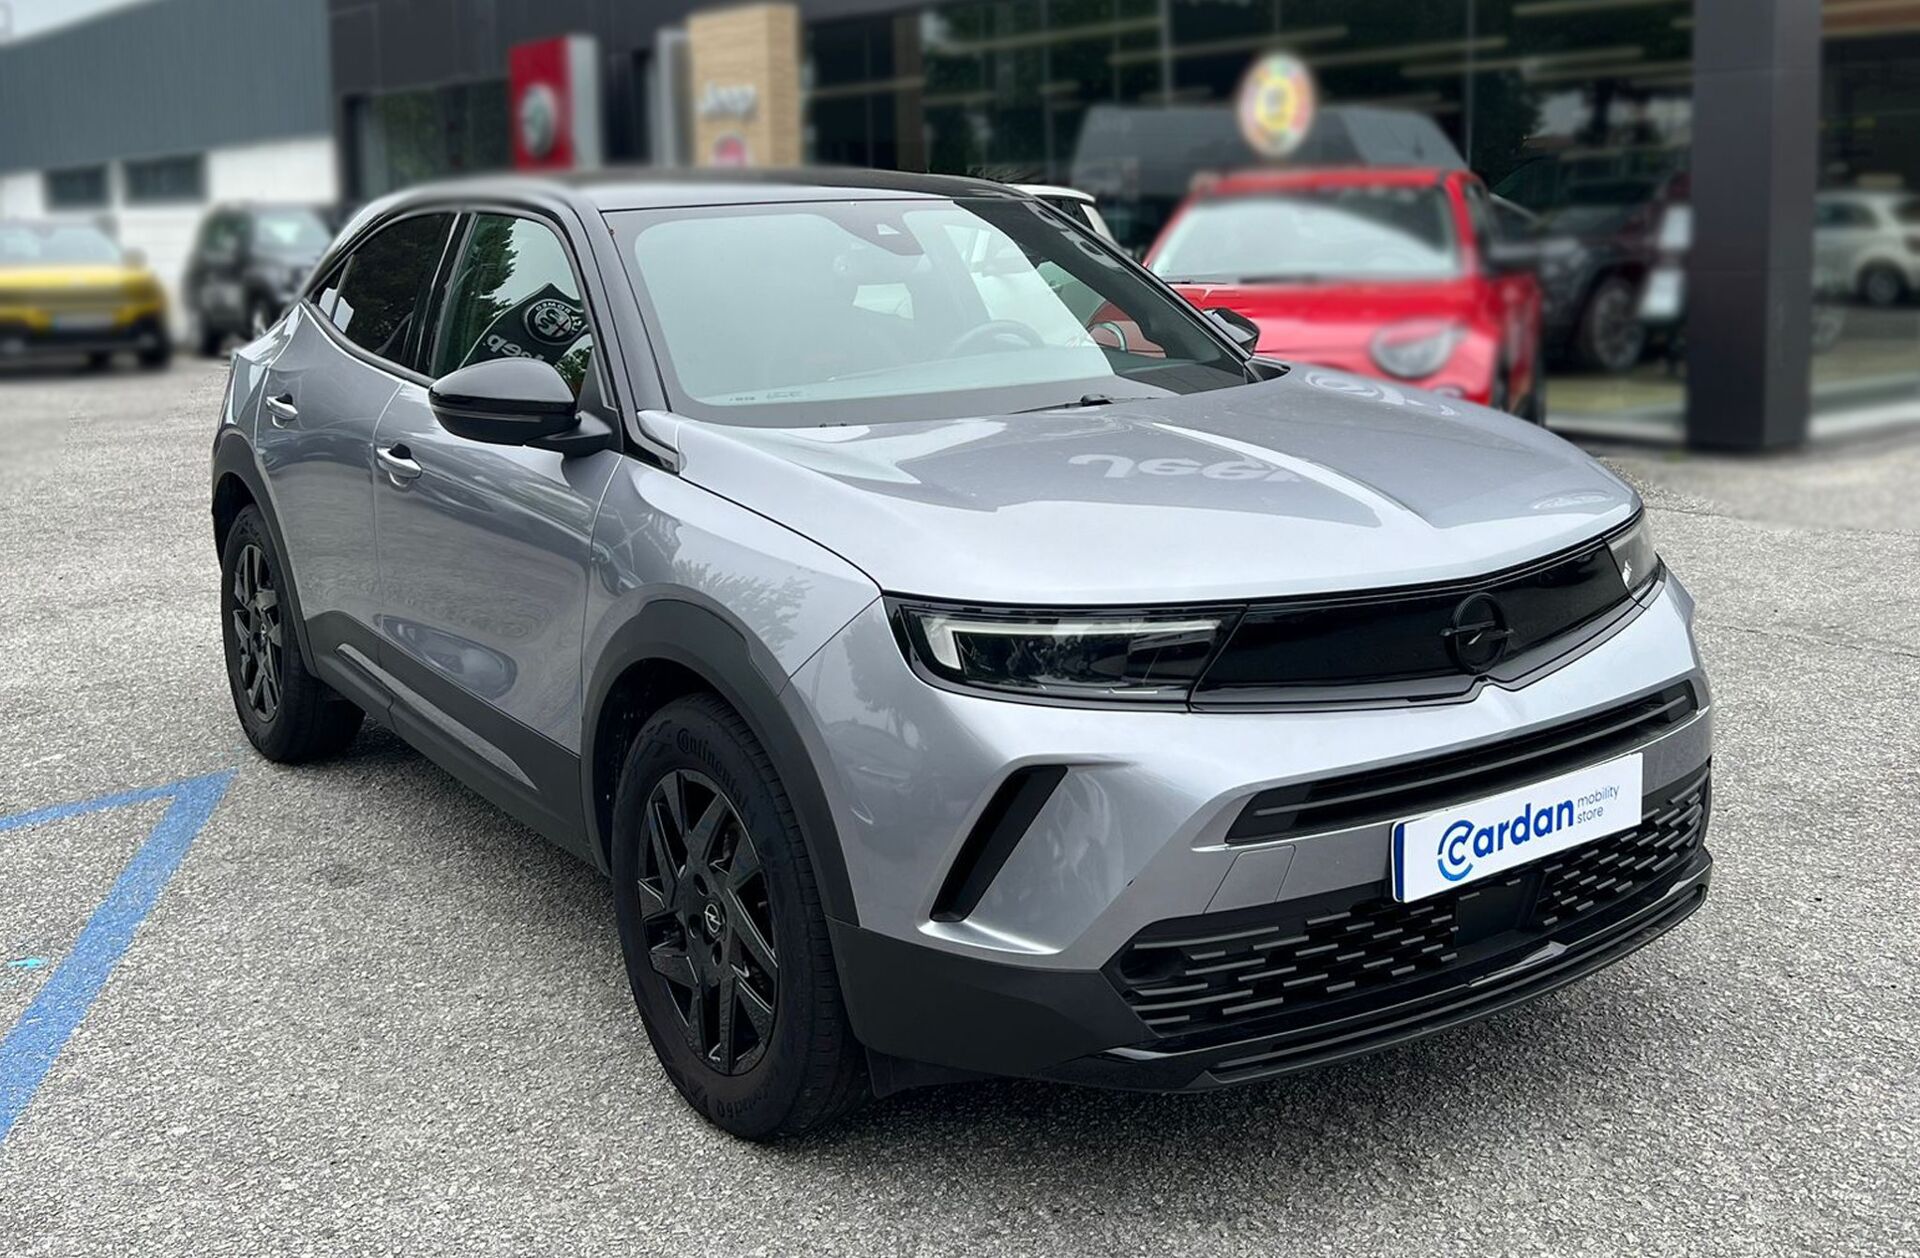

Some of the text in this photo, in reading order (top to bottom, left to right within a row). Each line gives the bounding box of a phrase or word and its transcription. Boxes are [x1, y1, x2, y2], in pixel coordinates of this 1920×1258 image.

[676, 727, 749, 811] Continental
[1437, 783, 1621, 882] Cardan mobility
[1577, 806, 1604, 825] store
